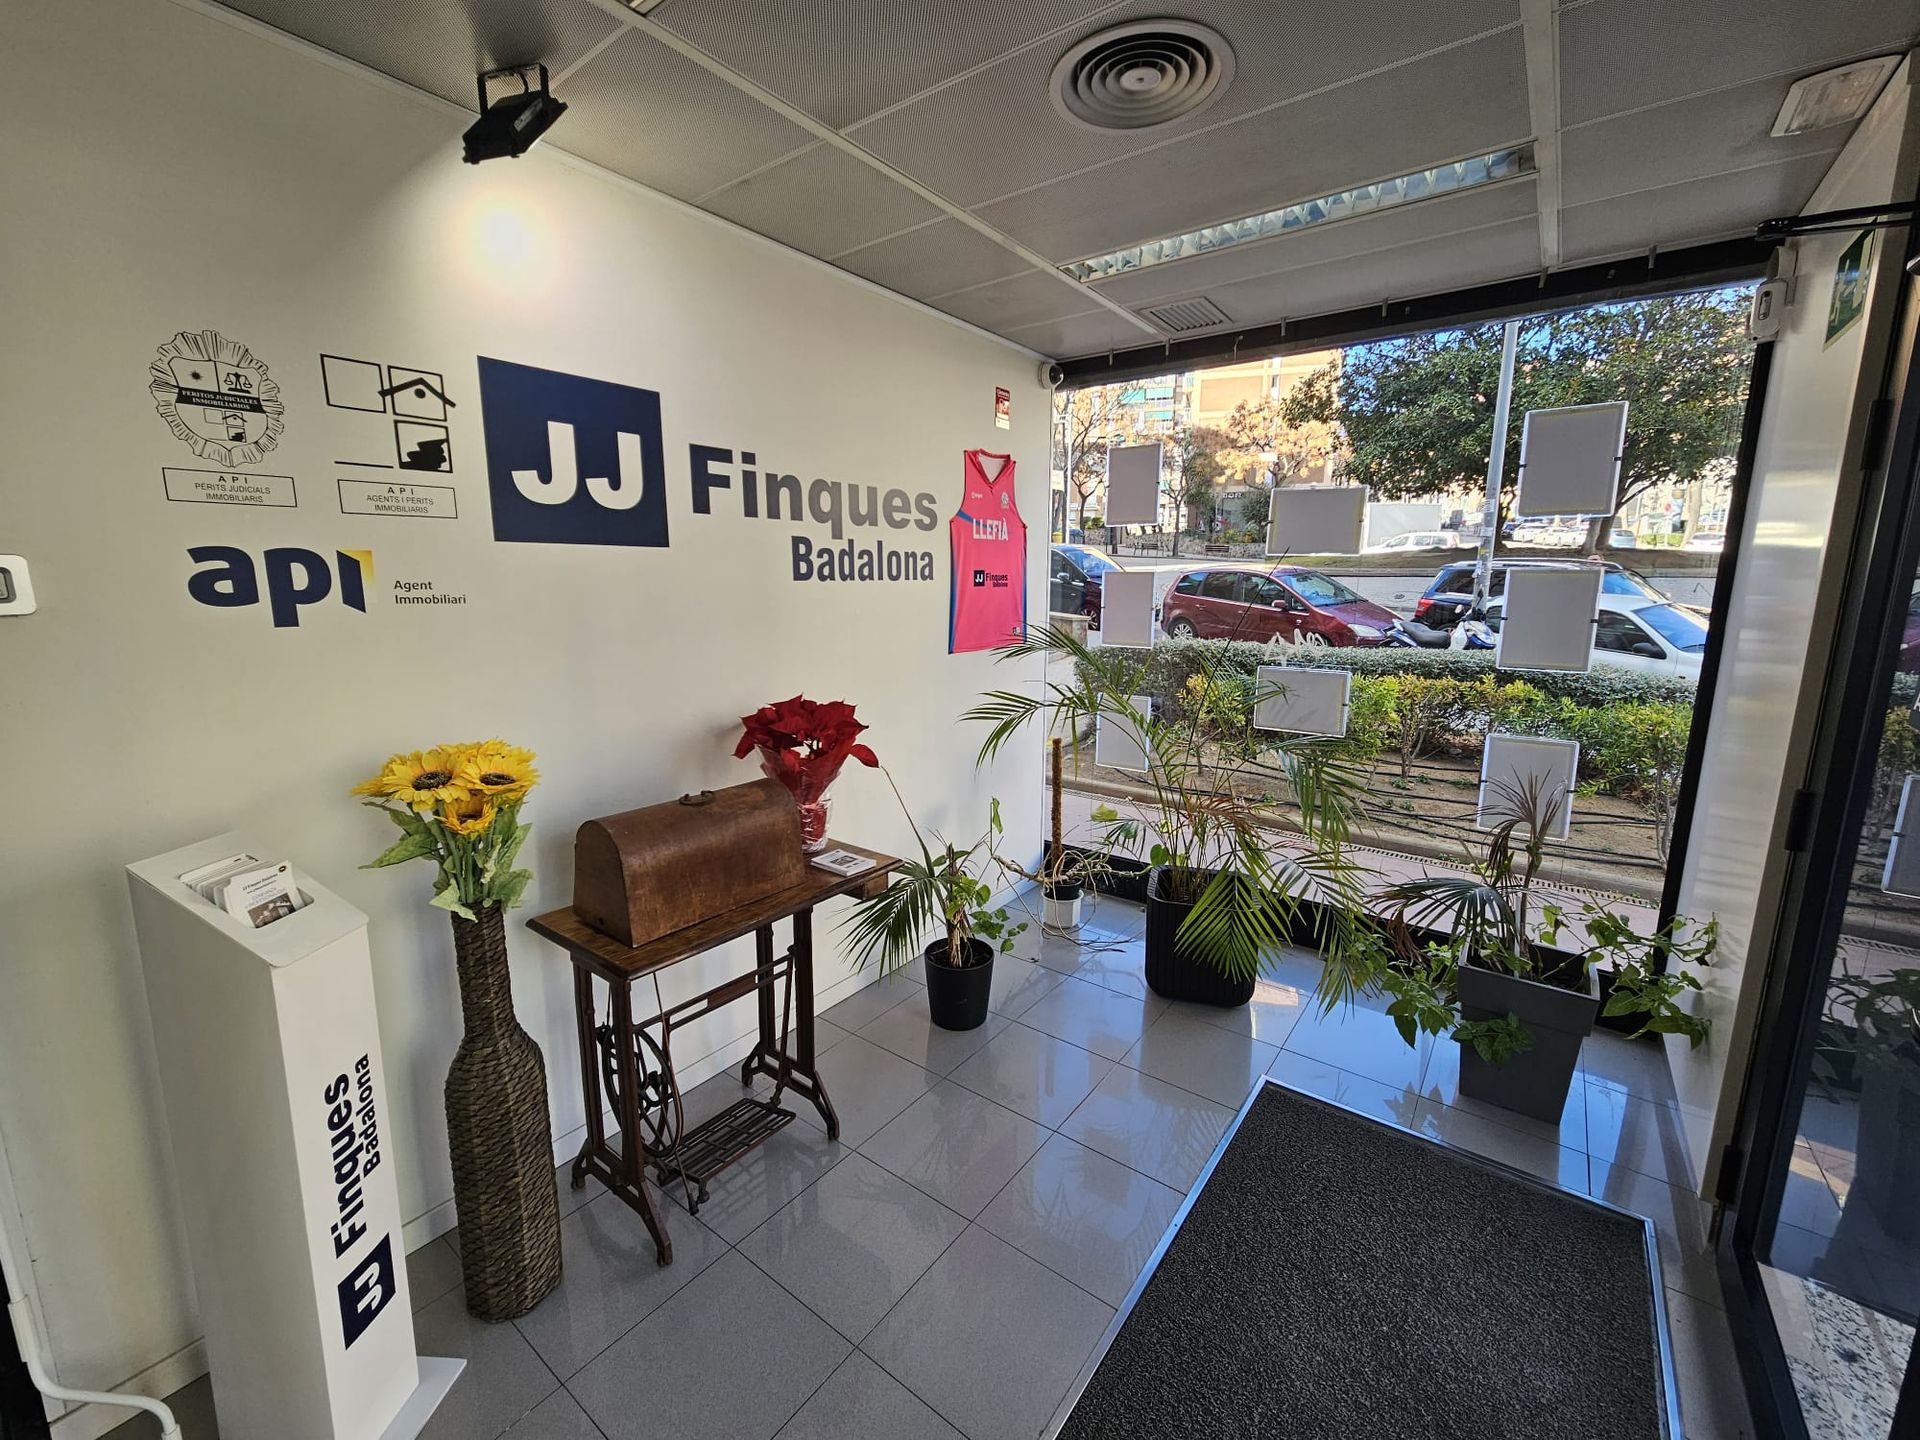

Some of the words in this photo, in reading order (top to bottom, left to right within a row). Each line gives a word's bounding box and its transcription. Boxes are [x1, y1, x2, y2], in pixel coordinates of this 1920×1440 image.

[215, 393, 258, 405] JUDICIALES
[511, 419, 643, 510] JJ
[194, 482, 227, 492] PERITS
[228, 485, 271, 495] JUDICIALS
[688, 442, 938, 540] Finques
[205, 492, 264, 503] IMMOBILIARIS
[366, 494, 400, 504] AGENTS
[406, 496, 434, 506] PERITS
[374, 503, 429, 514] IMMOBILIARIS
[972, 517, 1009, 541] LLEFIÀ
[791, 535, 935, 583] Badalona
[394, 581, 433, 594] Agent
[395, 593, 466, 605] Immobiliari
[354, 1052, 381, 1178] Badalona
[323, 1073, 367, 1260] Finques
